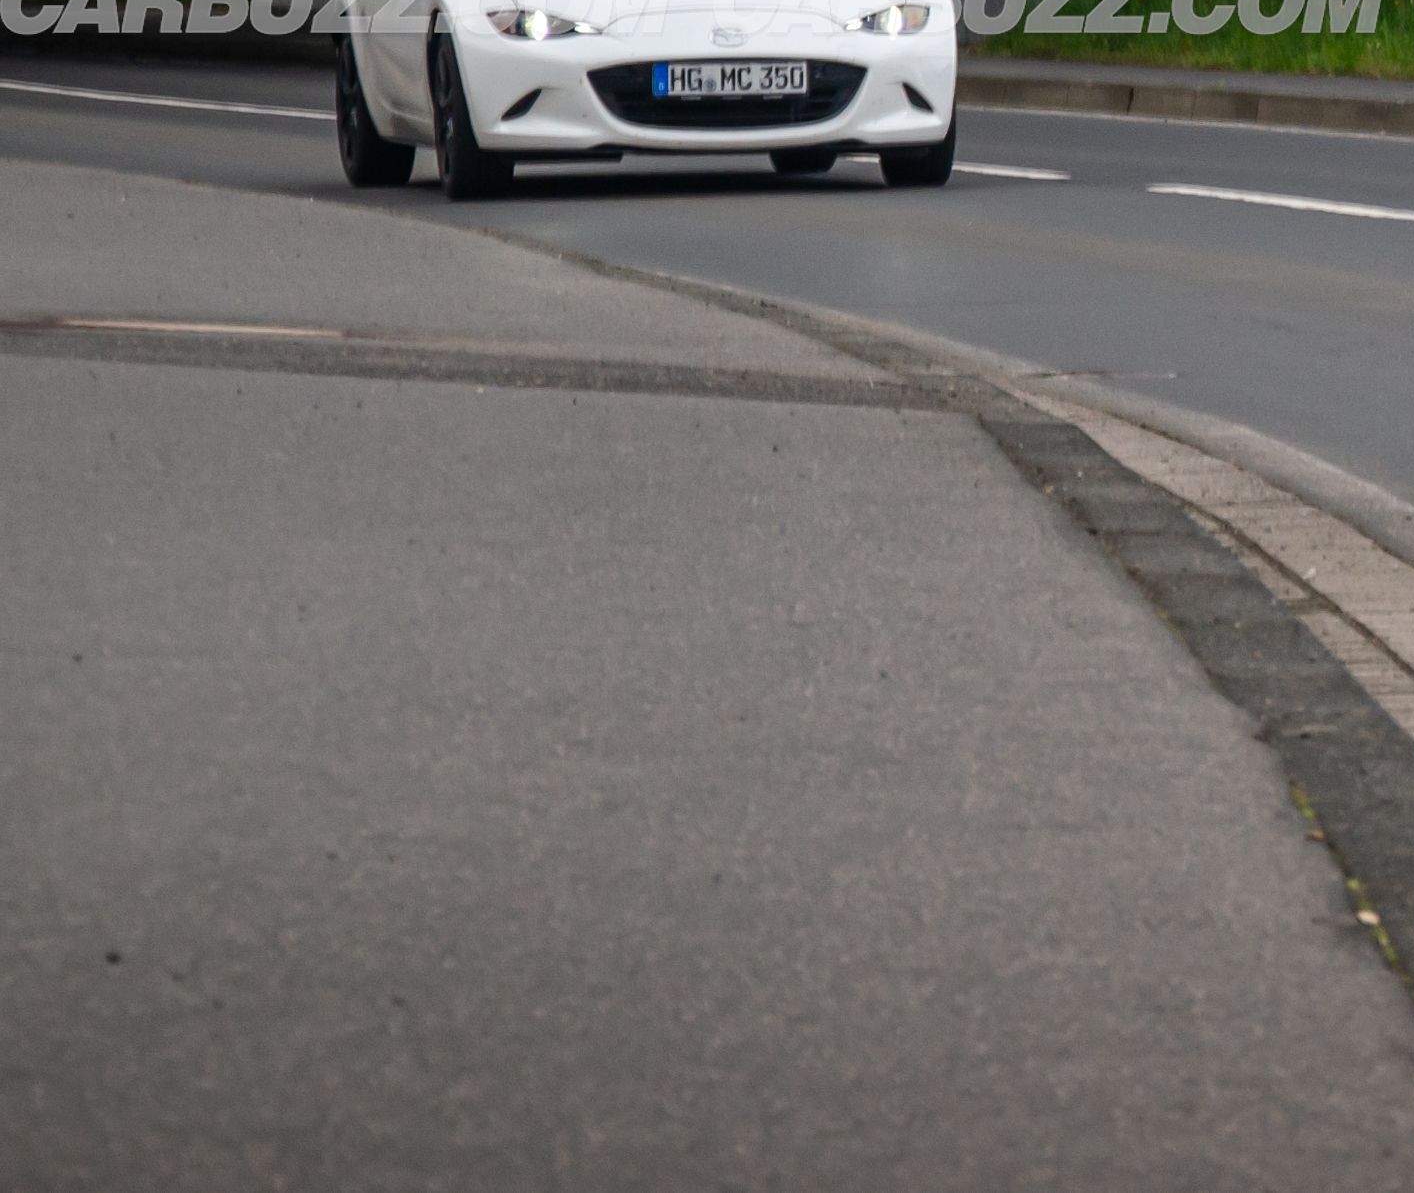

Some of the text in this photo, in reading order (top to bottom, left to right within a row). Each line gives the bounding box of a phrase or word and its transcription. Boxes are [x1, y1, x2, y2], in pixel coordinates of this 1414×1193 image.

[670, 67, 702, 92] HG
[720, 67, 752, 91] MC
[760, 66, 804, 90] 350
